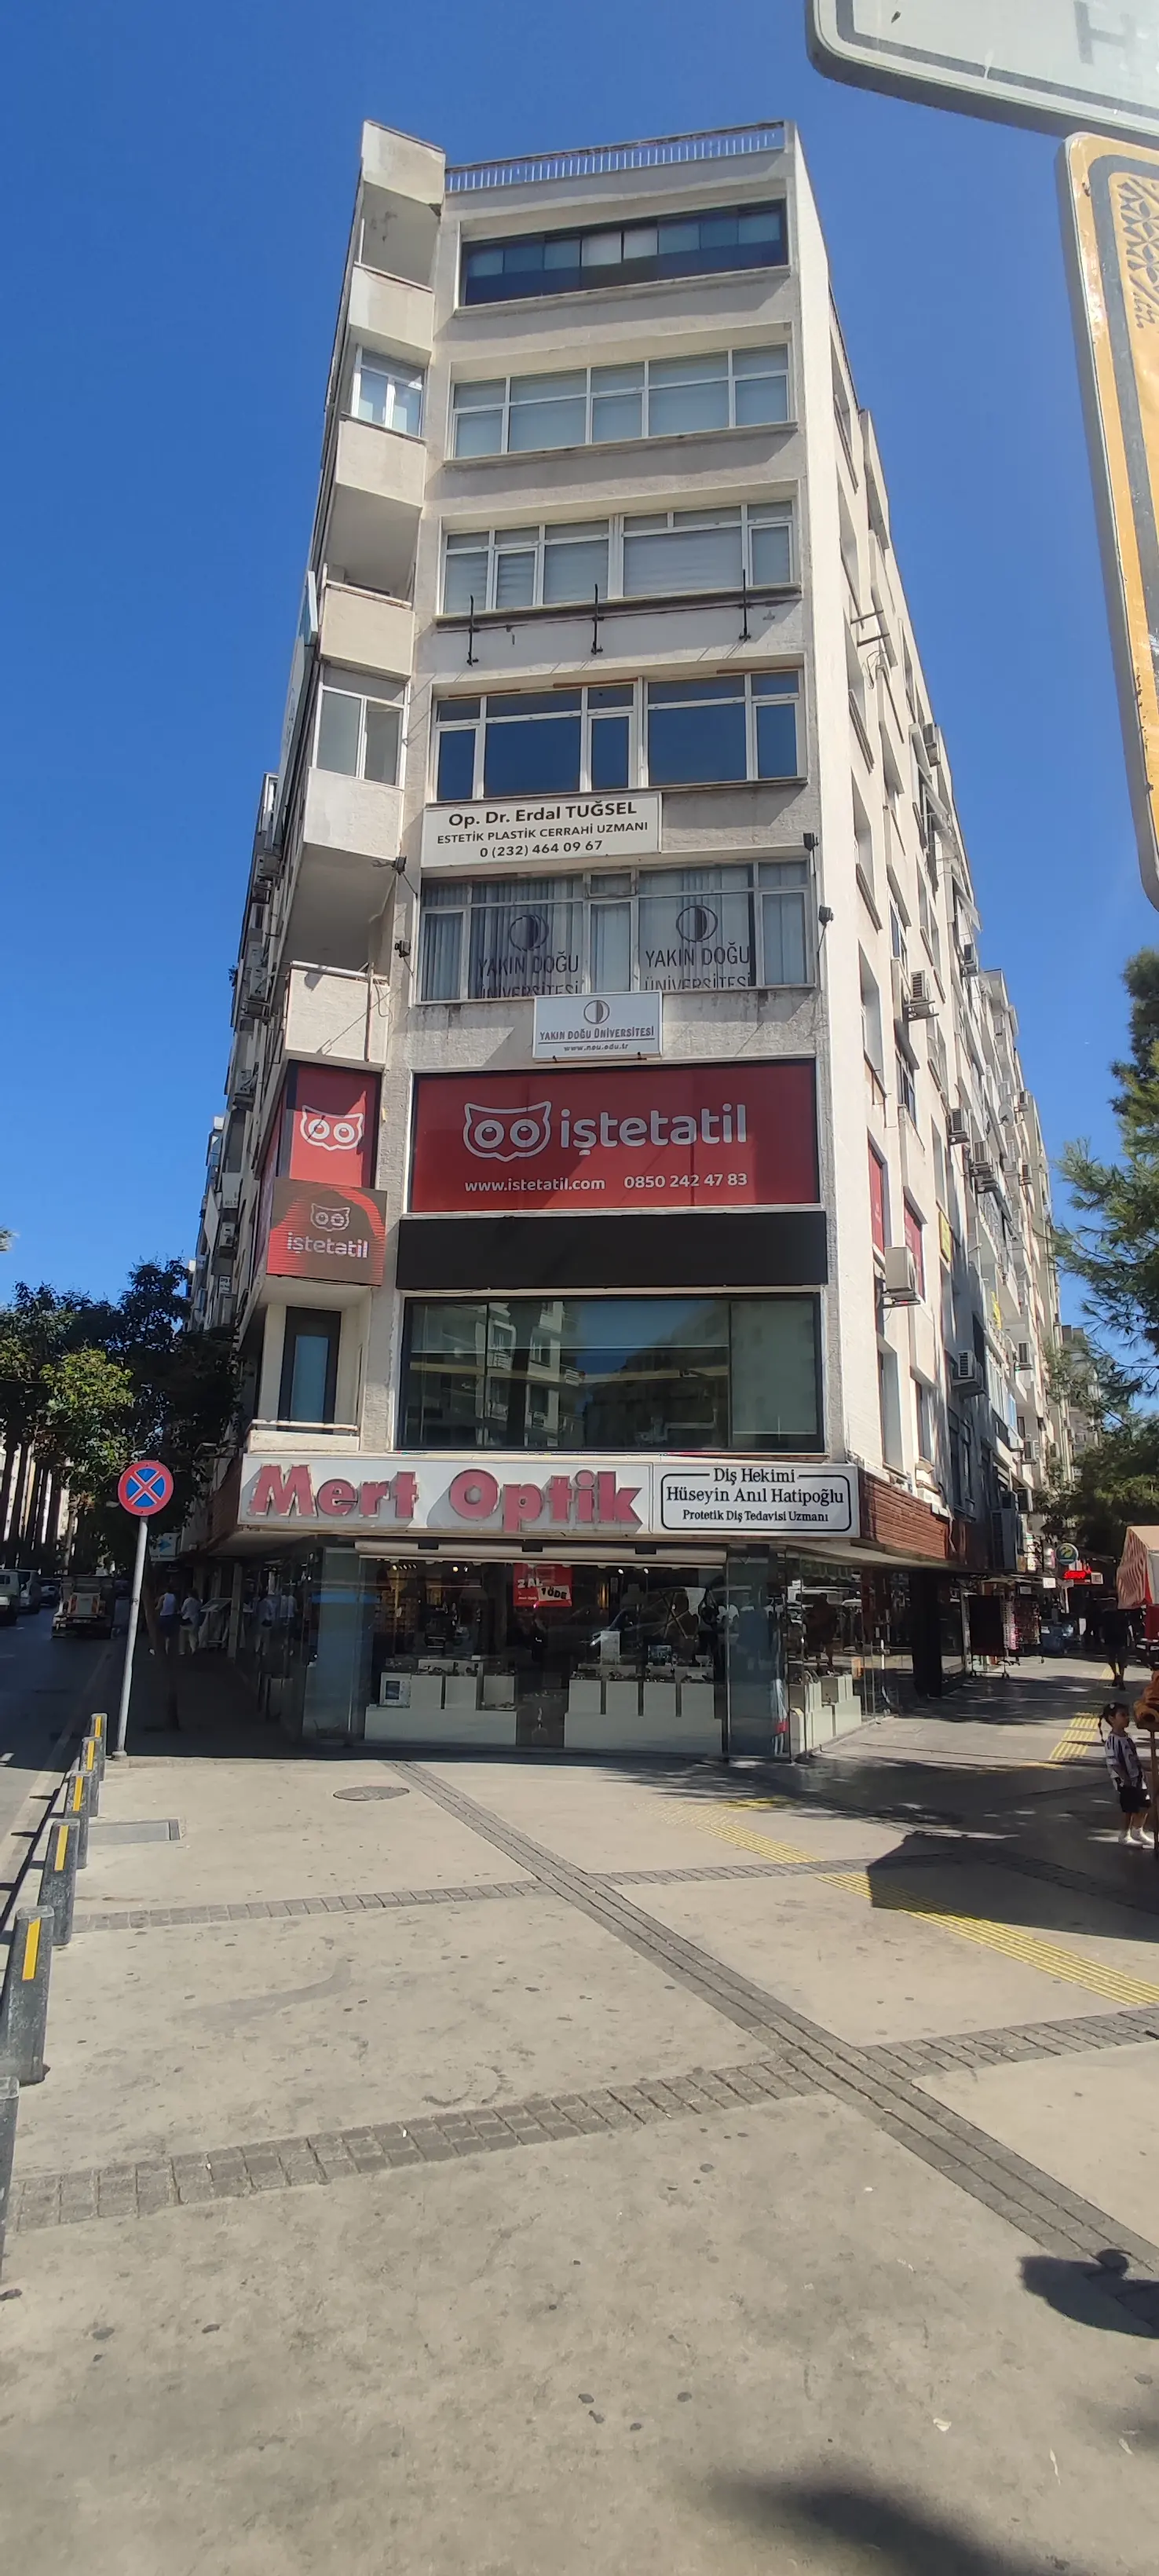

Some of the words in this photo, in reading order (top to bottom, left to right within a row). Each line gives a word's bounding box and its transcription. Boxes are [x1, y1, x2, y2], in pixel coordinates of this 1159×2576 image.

[448, 813, 480, 829] Op.
[486, 811, 510, 824] Dr.
[515, 806, 561, 822] Erdal
[565, 800, 637, 819] TUĞSEL
[437, 830, 484, 844] ESTETİK
[488, 827, 536, 841] PLASTİK
[539, 823, 593, 837] CERRAHİ
[597, 821, 648, 833] UZMANI
[480, 847, 488, 858] 0
[492, 844, 528, 858] (232)
[532, 843, 559, 854] 464
[563, 841, 581, 852] 09
[585, 840, 603, 851] 67
[477, 955, 525, 979] YAKIN
[532, 950, 579, 975] DOĞU
[645, 947, 695, 968] YAKIN
[701, 942, 751, 966] DOĞU
[539, 1030, 565, 1041] YAKIN
[568, 1028, 591, 1040] DOĞU
[594, 1026, 654, 1038] ÜNİVERSİTESİ
[560, 1103, 747, 1156] iştetatil
[464, 1176, 605, 1191] www.istetatil.com
[624, 1174, 666, 1189] 0850
[670, 1173, 700, 1187] 242
[704, 1173, 723, 1187] 47
[727, 1173, 748, 1186] 83
[713, 1467, 737, 1485] Diş
[740, 1468, 795, 1483] Hekimi
[249, 1464, 419, 1518] Mert
[448, 1468, 643, 1532] Optik
[666, 1486, 730, 1505] Hüseyin
[734, 1487, 767, 1503] Anıl
[770, 1488, 844, 1506] Hatipoğlu
[682, 1509, 724, 1520] Protetik
[726, 1510, 742, 1523] Diş
[744, 1510, 786, 1521] Tedavisi
[788, 1511, 828, 1522] Uzmanı
[528, 1577, 543, 1588] AL
